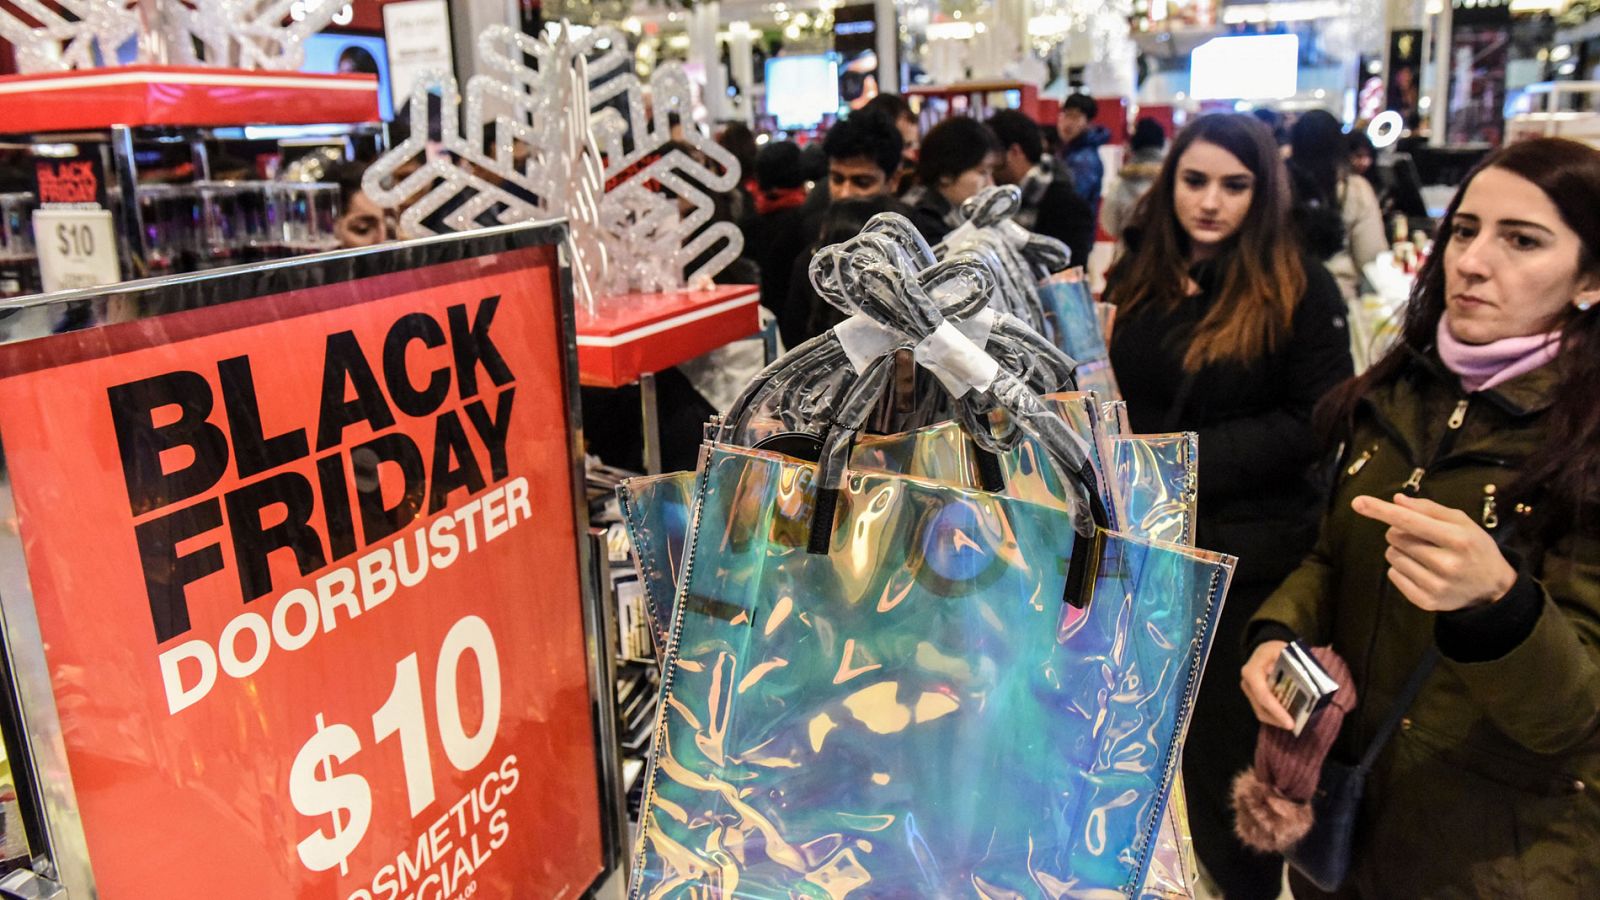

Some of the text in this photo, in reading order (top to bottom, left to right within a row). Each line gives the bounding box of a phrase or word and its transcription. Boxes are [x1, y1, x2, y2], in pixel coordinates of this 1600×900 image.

[36, 161, 94, 182] BLACK
[55, 222, 94, 257] $10
[107, 294, 516, 517] BLACK
[134, 386, 516, 644] FRIDAY
[158, 476, 533, 716] DOORBUSTER
[288, 615, 502, 877] $10
[346, 754, 520, 900] SMETICS
[406, 808, 510, 900] CIALS
